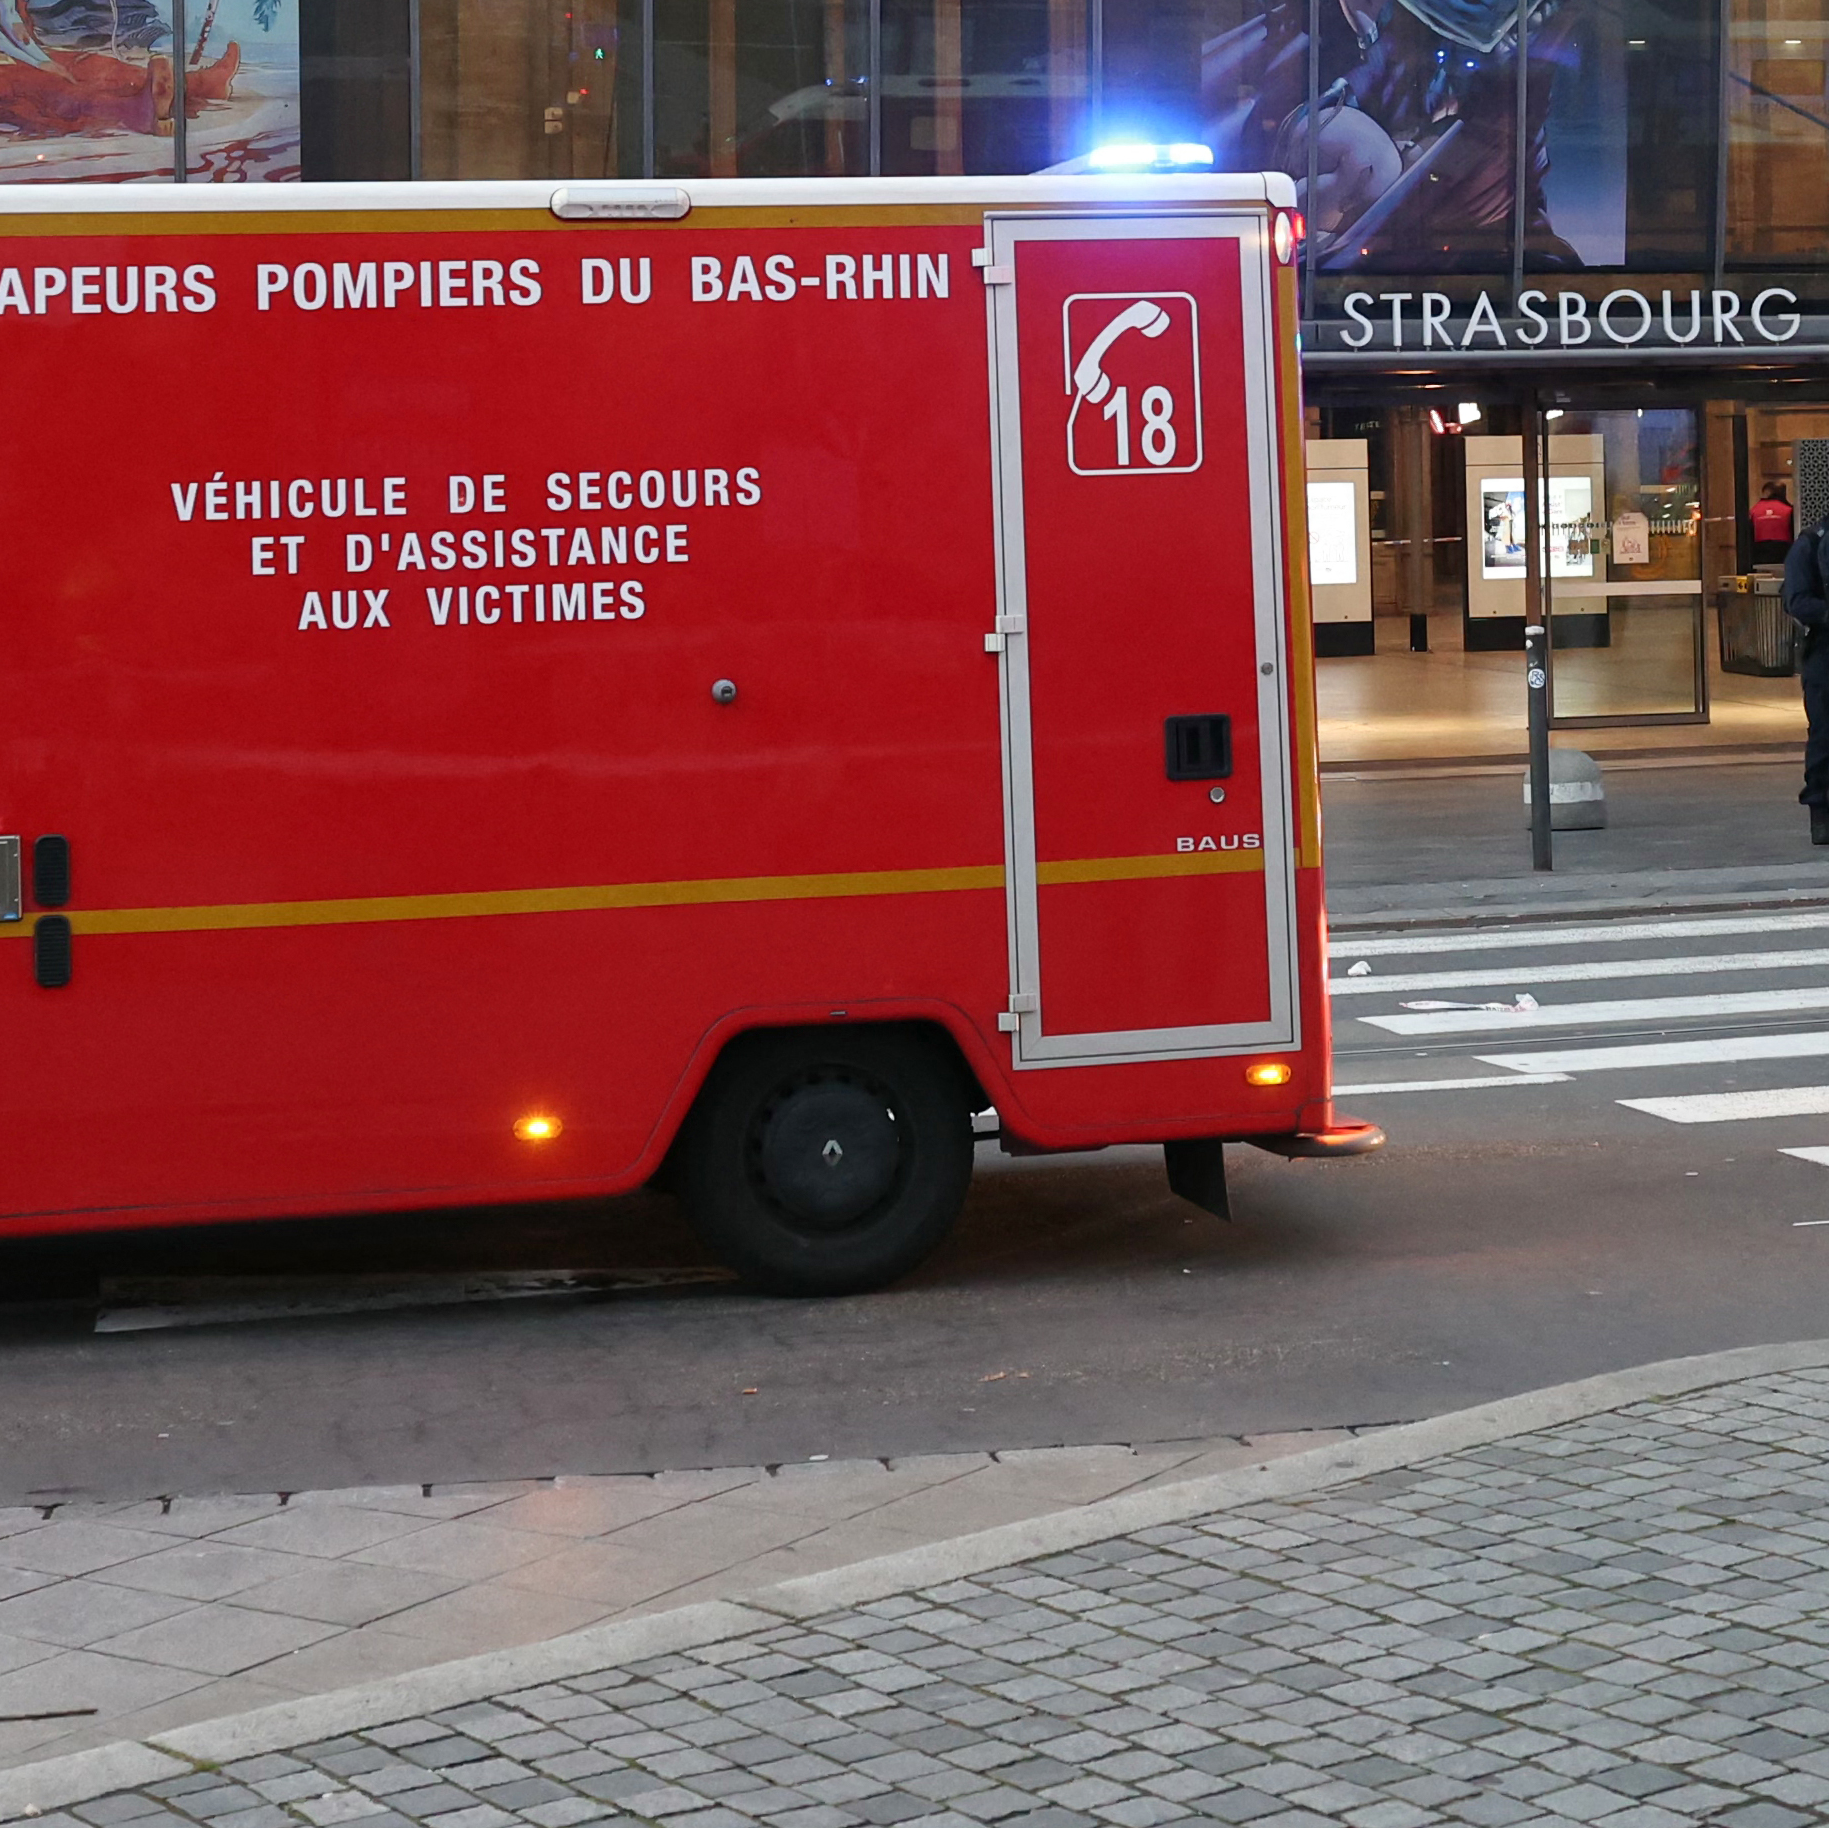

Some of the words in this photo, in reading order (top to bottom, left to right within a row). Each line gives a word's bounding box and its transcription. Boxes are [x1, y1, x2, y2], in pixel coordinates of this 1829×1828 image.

[258, 259, 541, 310] POMPIERS
[582, 258, 650, 303] DU
[692, 254, 948, 301] BAS-RHIN
[1340, 288, 1802, 348] STRASBOURG
[1103, 386, 1175, 466] 18
[171, 472, 406, 520] VÉHICULE
[450, 475, 505, 513] DE
[547, 468, 760, 510] SECOURS
[252, 536, 304, 574] ET
[347, 525, 688, 572] D'ASSISTANCE
[299, 590, 390, 629] AUX
[427, 581, 644, 626] VICTIMES
[1177, 834, 1260, 851] BAUS
